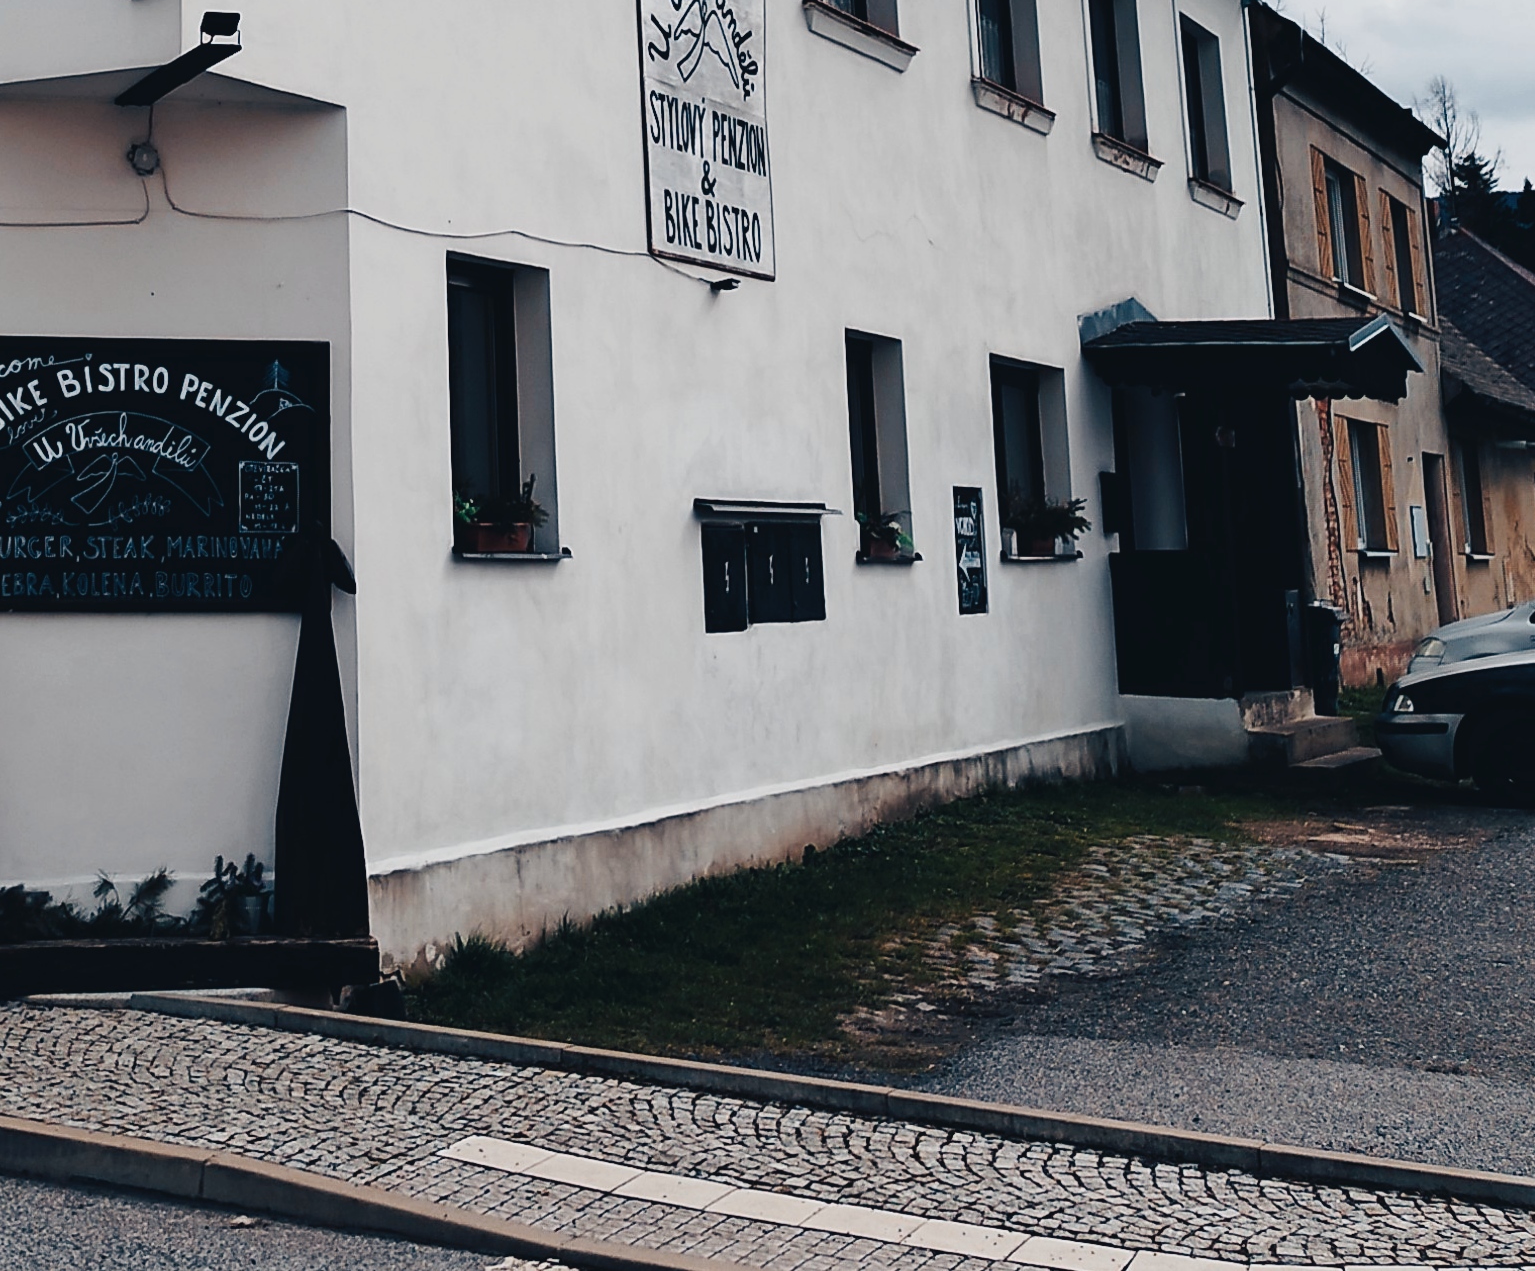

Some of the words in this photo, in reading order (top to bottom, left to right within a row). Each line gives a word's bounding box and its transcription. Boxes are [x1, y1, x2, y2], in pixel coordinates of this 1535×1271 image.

[648, 90, 706, 159] STYLOVÝ
[711, 108, 767, 178] PENZION
[701, 160, 717, 197] &
[664, 188, 703, 251] BIKE
[705, 198, 762, 263] BISTRO
[57, 362, 170, 400] BISTRO
[180, 372, 287, 460] PENZION
[155, 571, 253, 598] BURRITO
